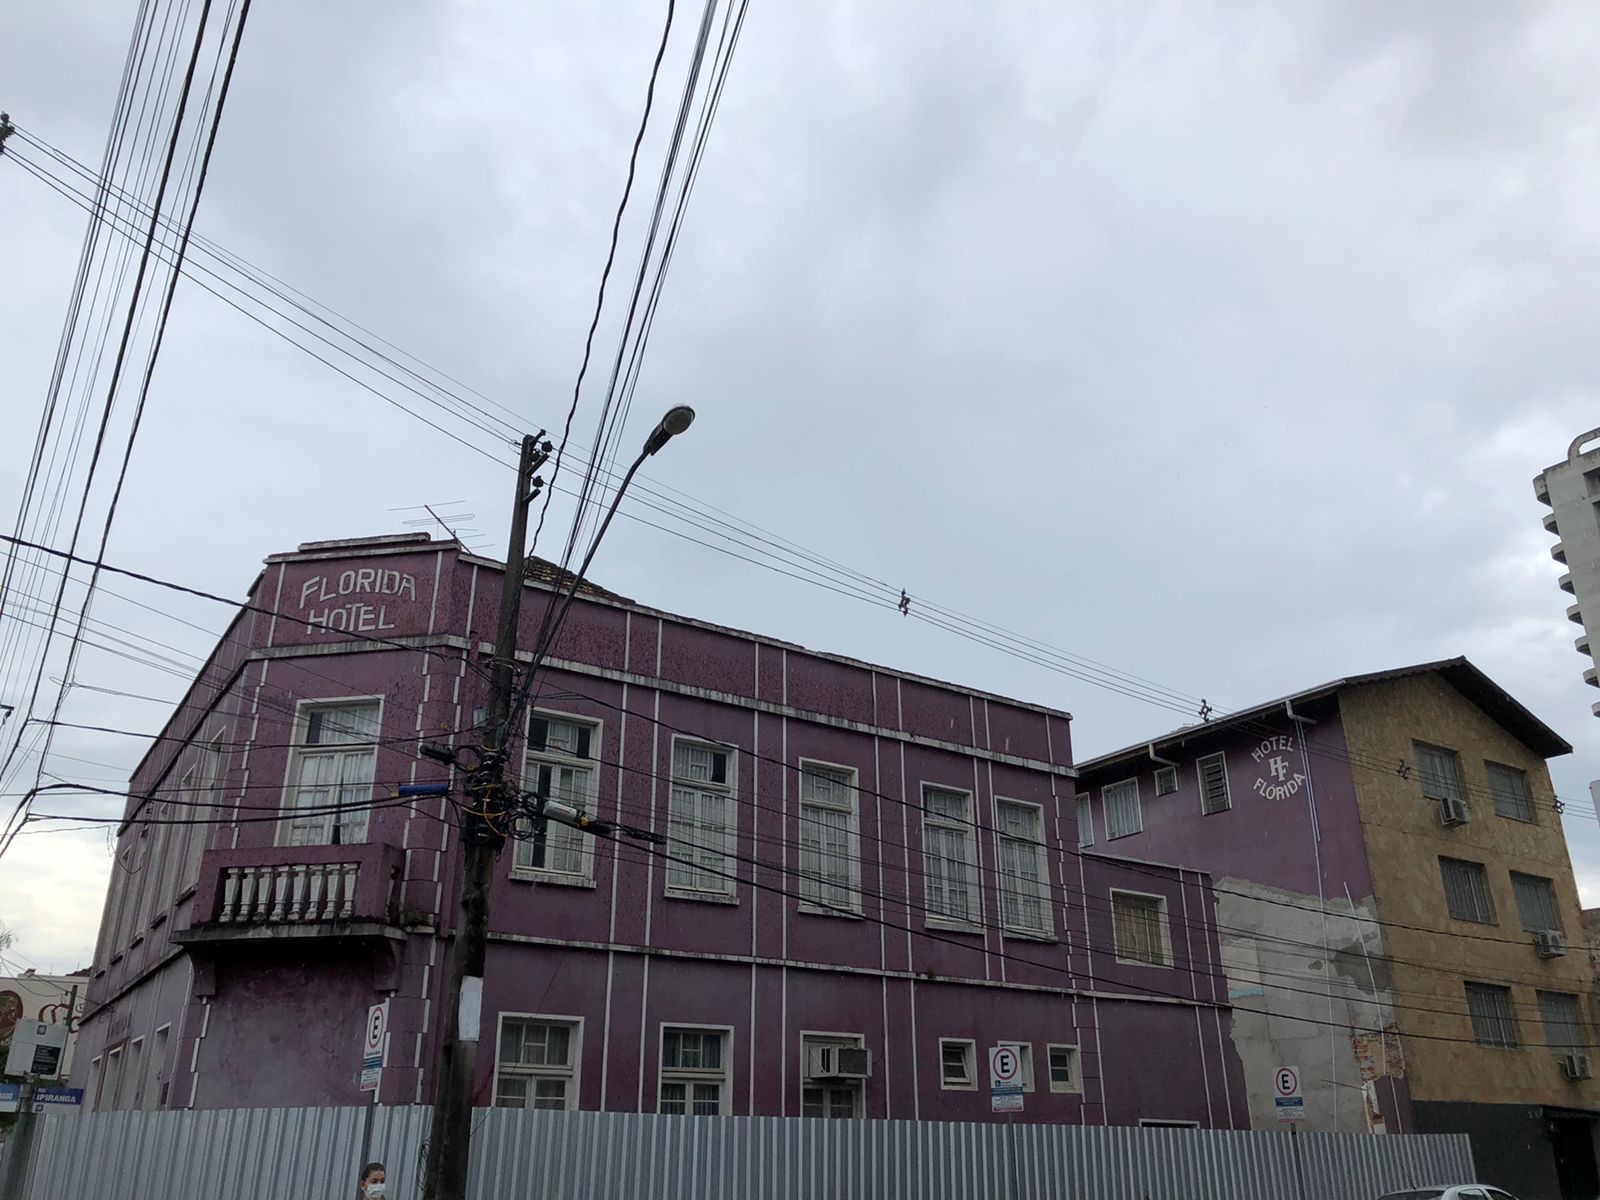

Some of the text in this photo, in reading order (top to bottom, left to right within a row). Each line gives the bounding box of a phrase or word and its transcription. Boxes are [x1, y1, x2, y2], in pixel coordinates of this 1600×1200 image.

[299, 568, 416, 609] FLORIDA
[306, 602, 395, 635] HOTEL
[1250, 735, 1294, 763] HOTEL
[371, 1015, 380, 1040] E
[1000, 1054, 1011, 1073] E
[1281, 1073, 1291, 1090] E
[36, 1093, 77, 1103] IPIRANGA
